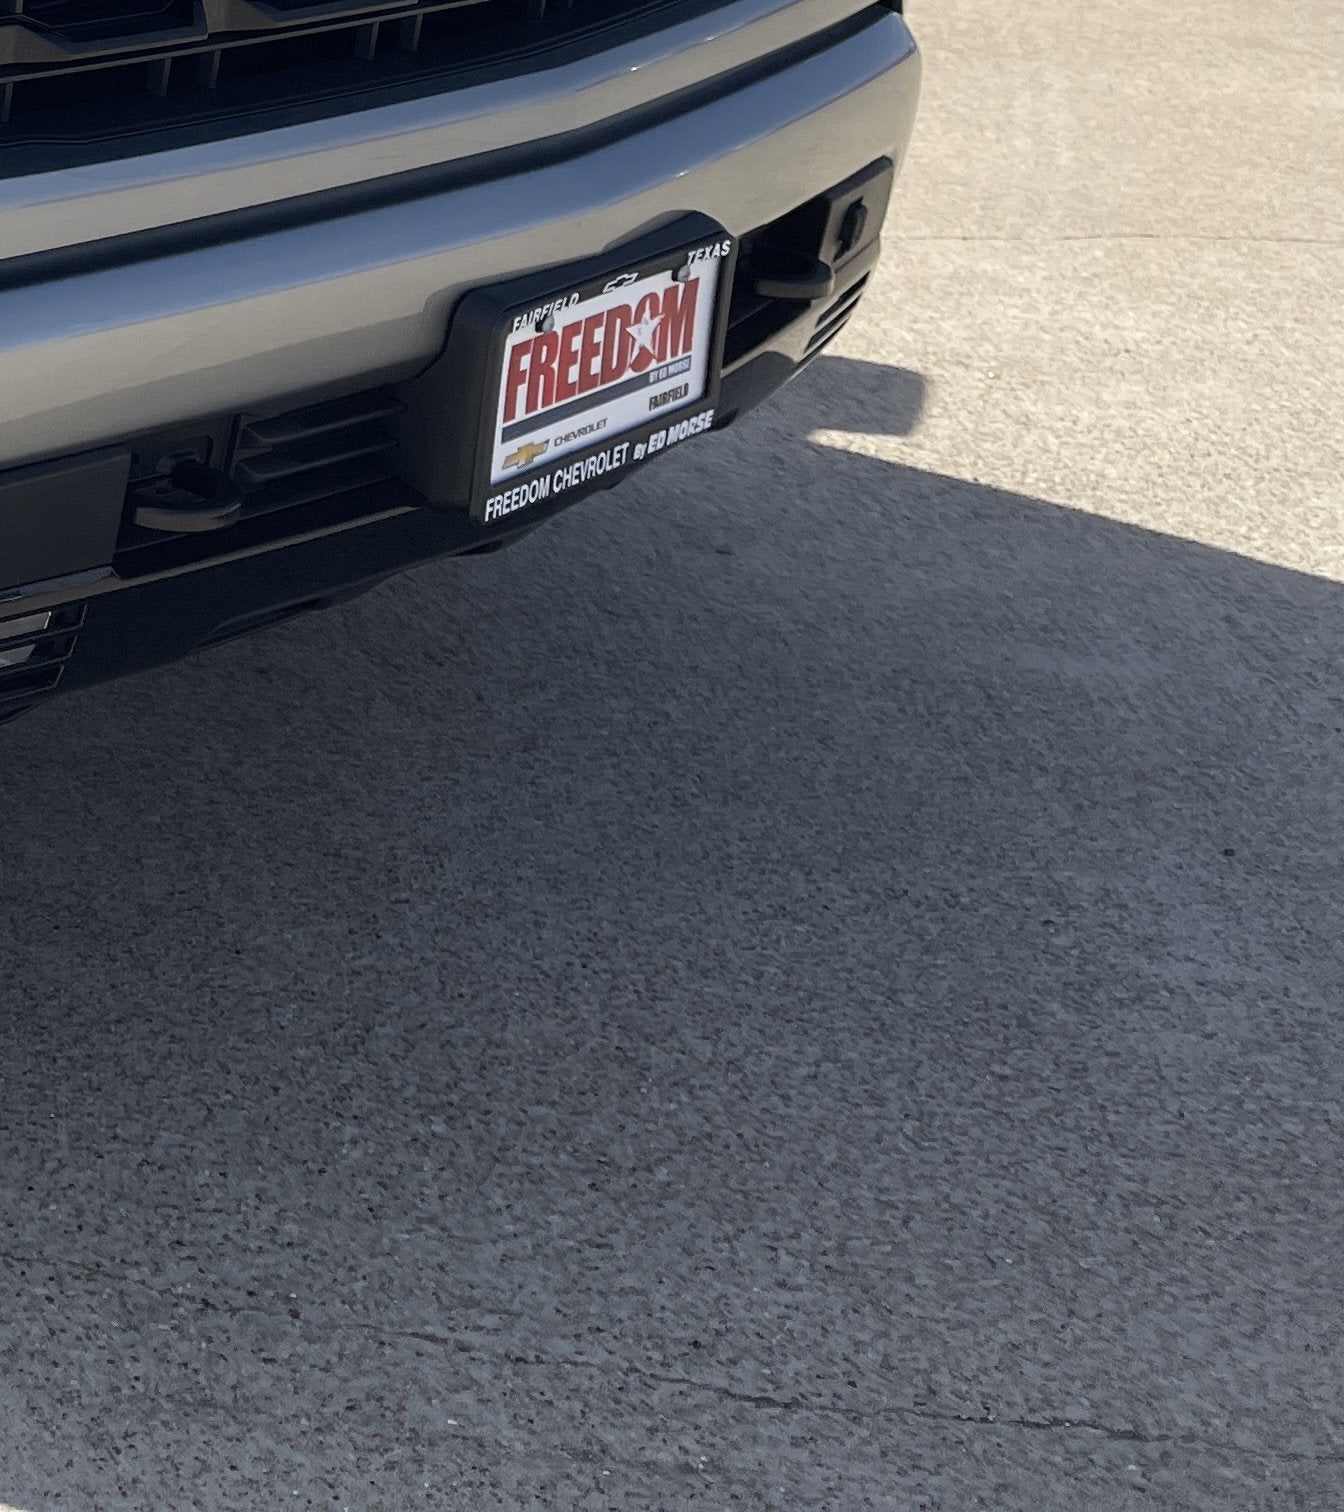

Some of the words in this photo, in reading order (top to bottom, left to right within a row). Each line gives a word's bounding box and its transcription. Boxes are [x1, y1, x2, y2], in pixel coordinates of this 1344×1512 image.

[512, 292, 580, 333] FAIRFIELD
[686, 240, 731, 265] TEXAS
[502, 276, 701, 424] FREEDOM
[484, 474, 550, 522] FREEDOM
[552, 441, 630, 494] CHEVROLET
[647, 430, 666, 454] ED
[666, 409, 715, 446] MORSE
[554, 418, 608, 447] CHEVROLET
